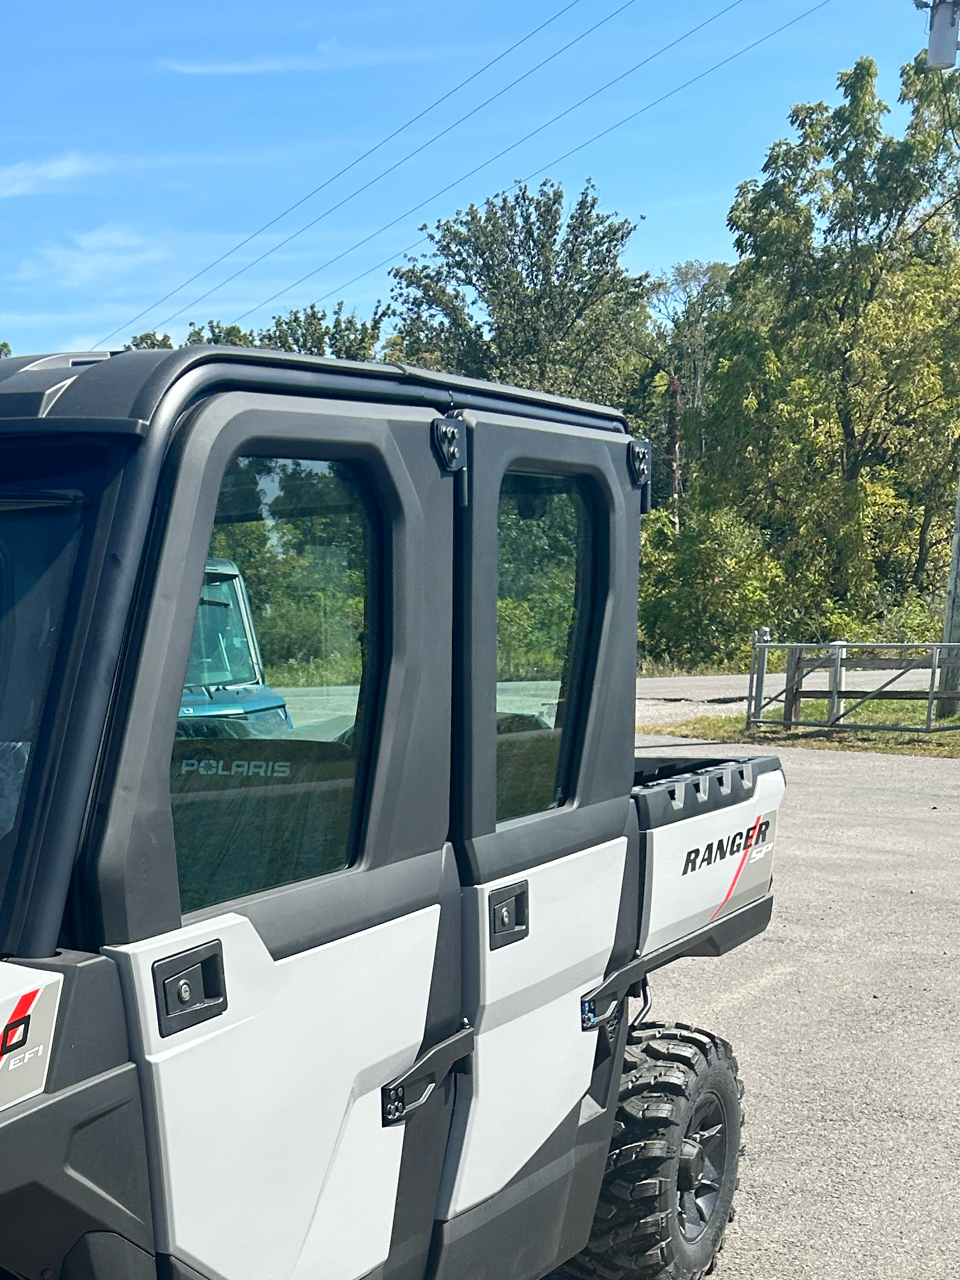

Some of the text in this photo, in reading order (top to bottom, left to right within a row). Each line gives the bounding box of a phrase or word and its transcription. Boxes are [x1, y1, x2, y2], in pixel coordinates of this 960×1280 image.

[181, 759, 291, 777] POLARIS
[681, 821, 770, 876] RANGER
[749, 844, 773, 864] SP
[8, 1044, 43, 1071] EFI
